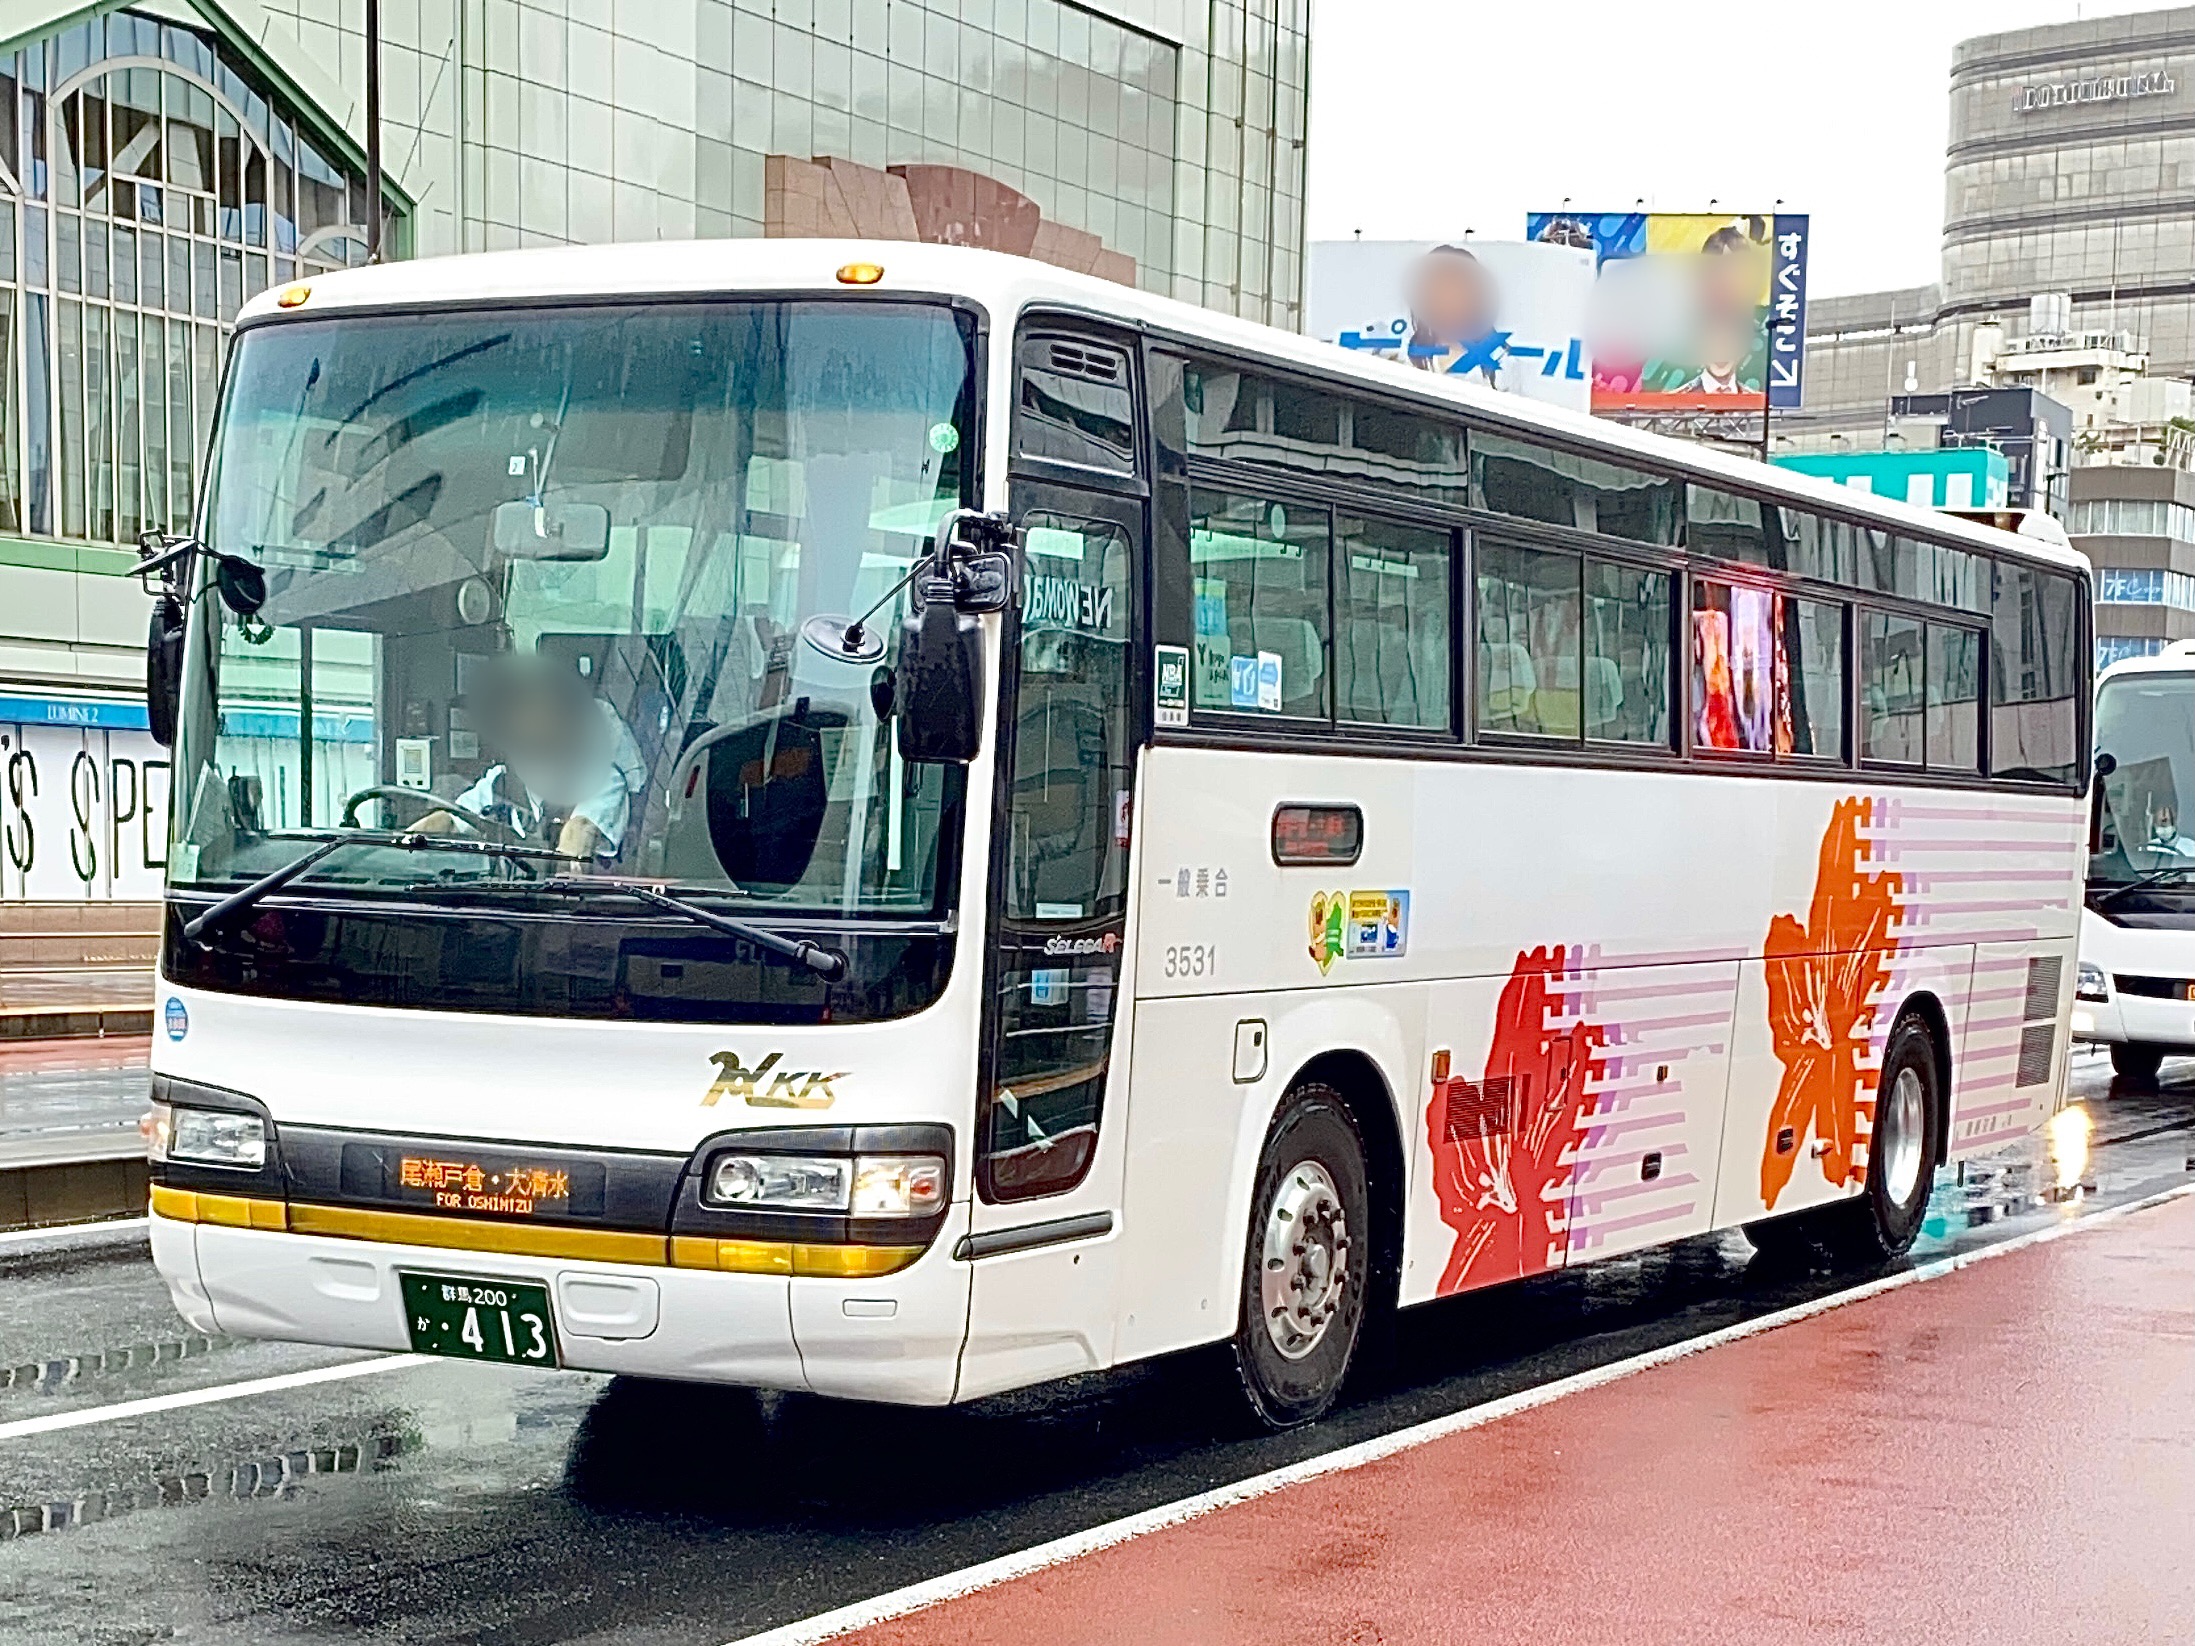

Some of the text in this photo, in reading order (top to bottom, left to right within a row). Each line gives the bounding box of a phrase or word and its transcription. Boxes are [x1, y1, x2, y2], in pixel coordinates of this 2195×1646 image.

[1157, 867, 1228, 898] 一般乗合
[1164, 946, 1216, 978] 3531
[435, 1192, 533, 1214] FOR OSHIMIZU
